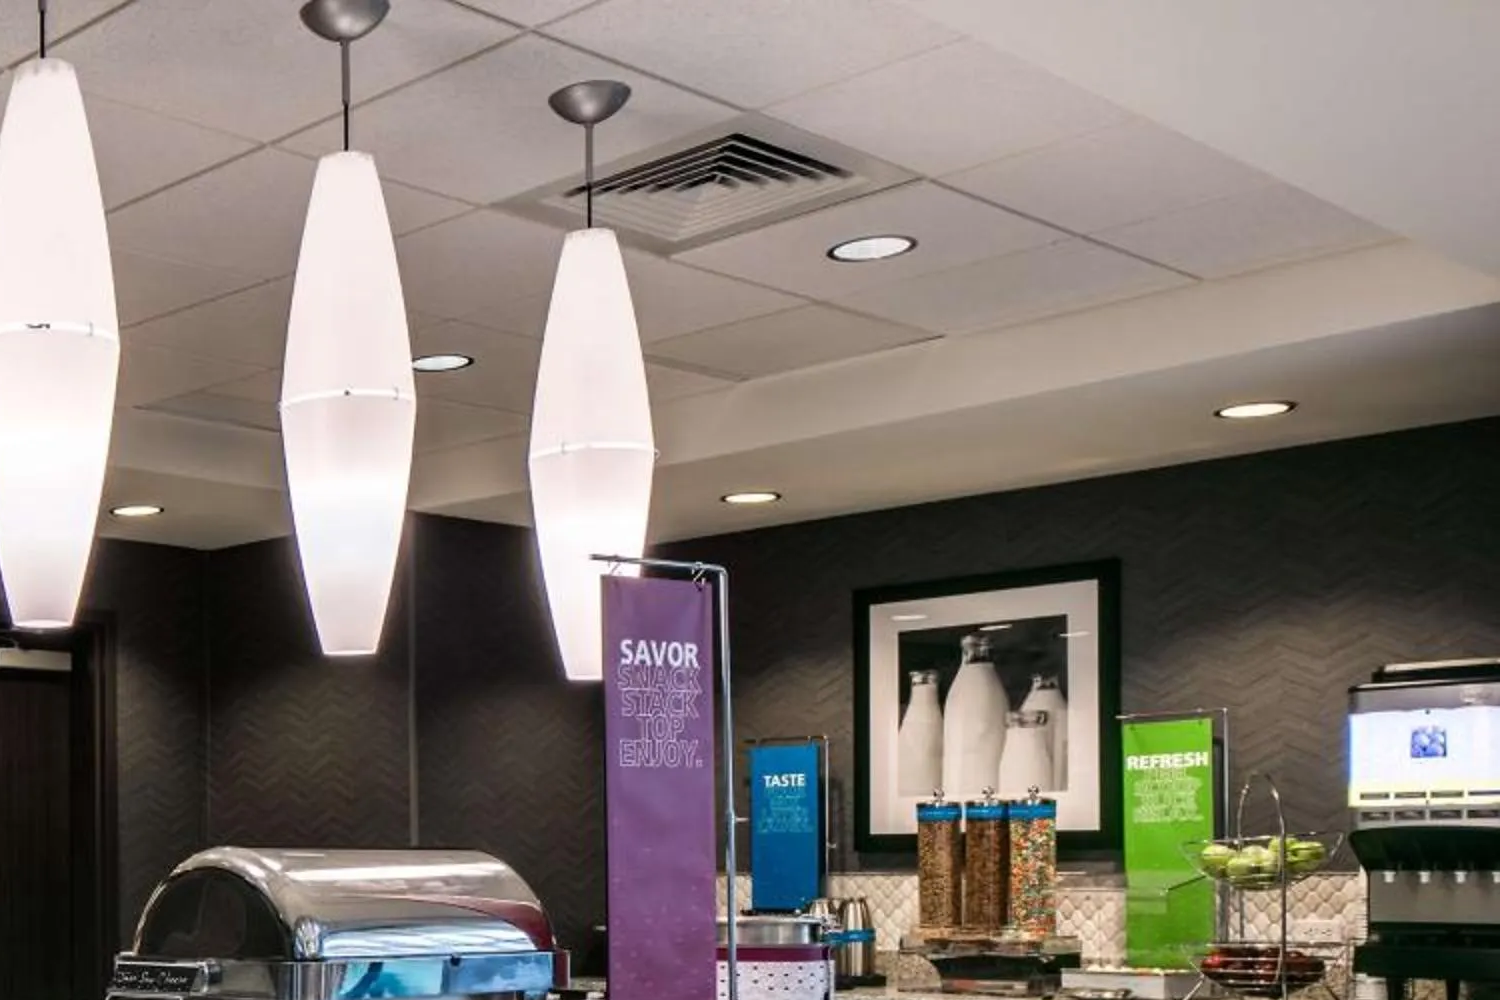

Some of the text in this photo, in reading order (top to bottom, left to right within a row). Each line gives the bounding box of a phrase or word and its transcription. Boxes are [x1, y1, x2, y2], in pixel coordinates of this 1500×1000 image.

[620, 639, 699, 668] SAVOR
[617, 664, 701, 693] SNACK
[621, 689, 699, 718] STACK
[636, 715, 685, 742] TOP
[619, 739, 703, 768] ENJOY.
[1126, 752, 1209, 770] REFRESH
[764, 773, 806, 788] TASTE
